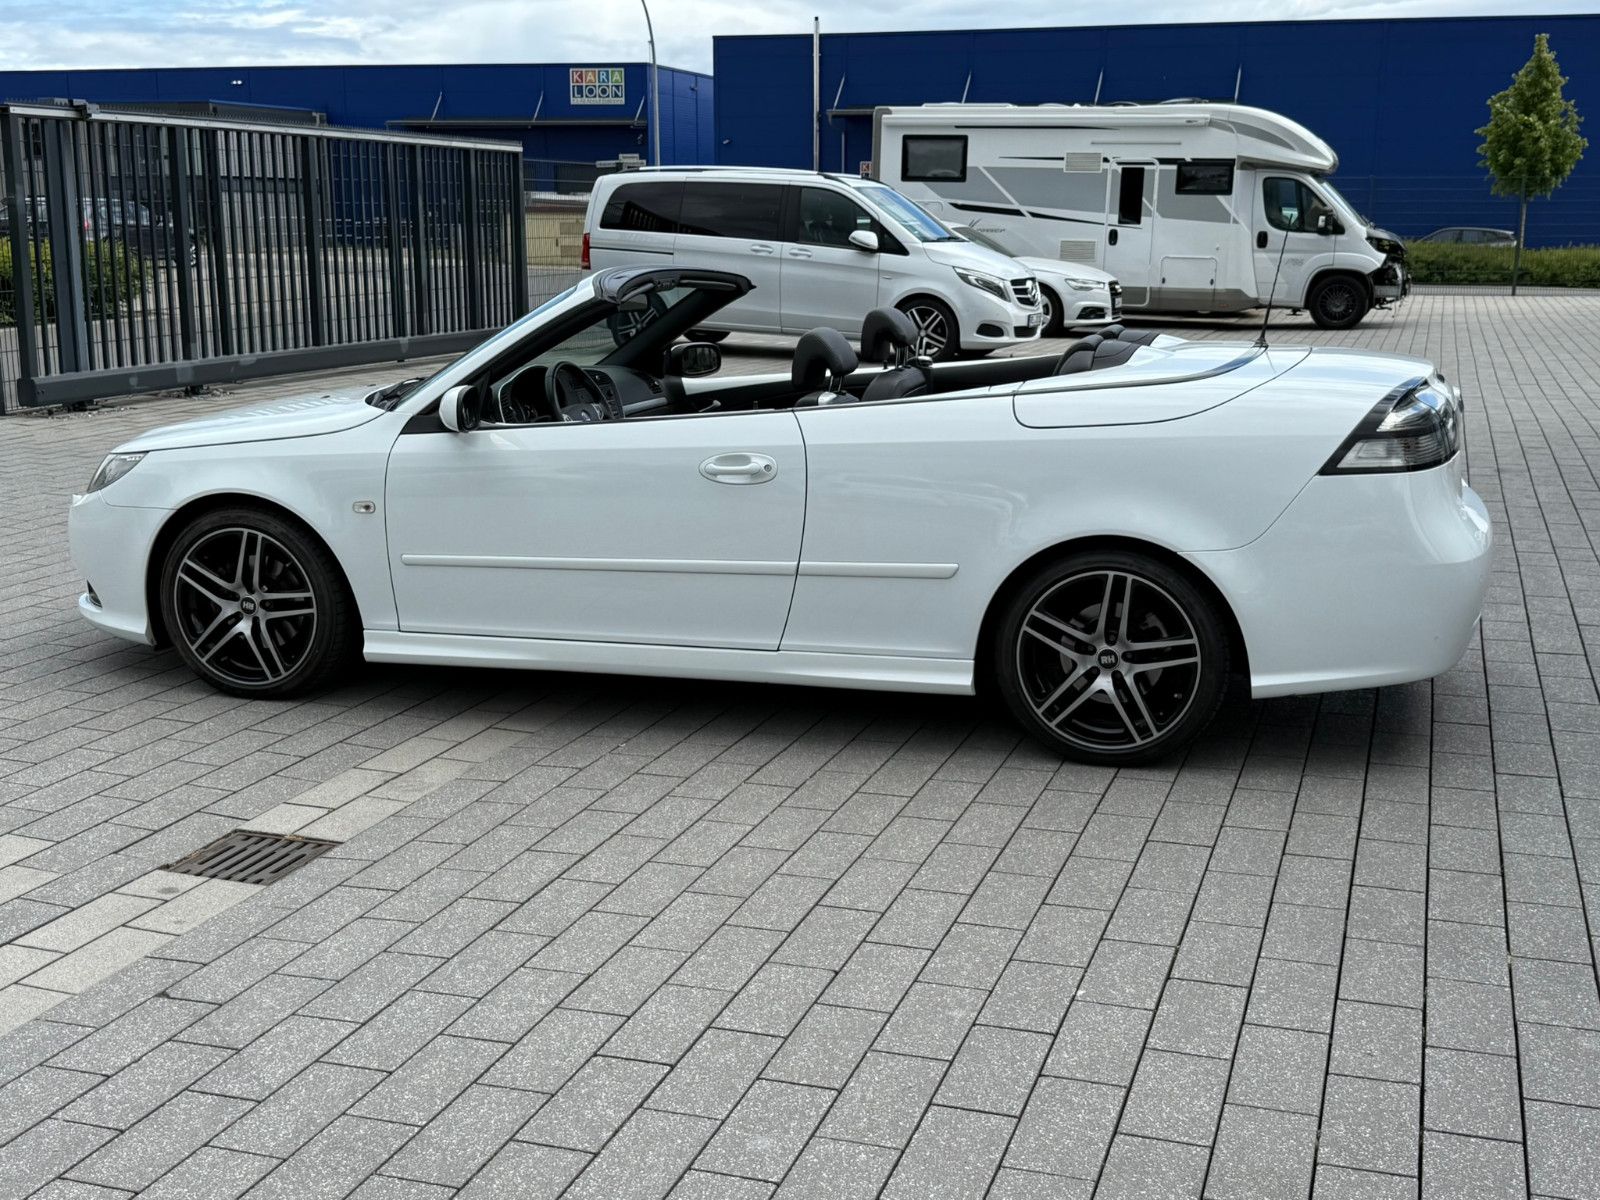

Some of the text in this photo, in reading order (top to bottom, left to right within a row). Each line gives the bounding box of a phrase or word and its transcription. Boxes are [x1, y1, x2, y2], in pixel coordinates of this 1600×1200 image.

[573, 71, 622, 83] KARA
[574, 85, 622, 98] LOON
[1100, 655, 1115, 664] RH
